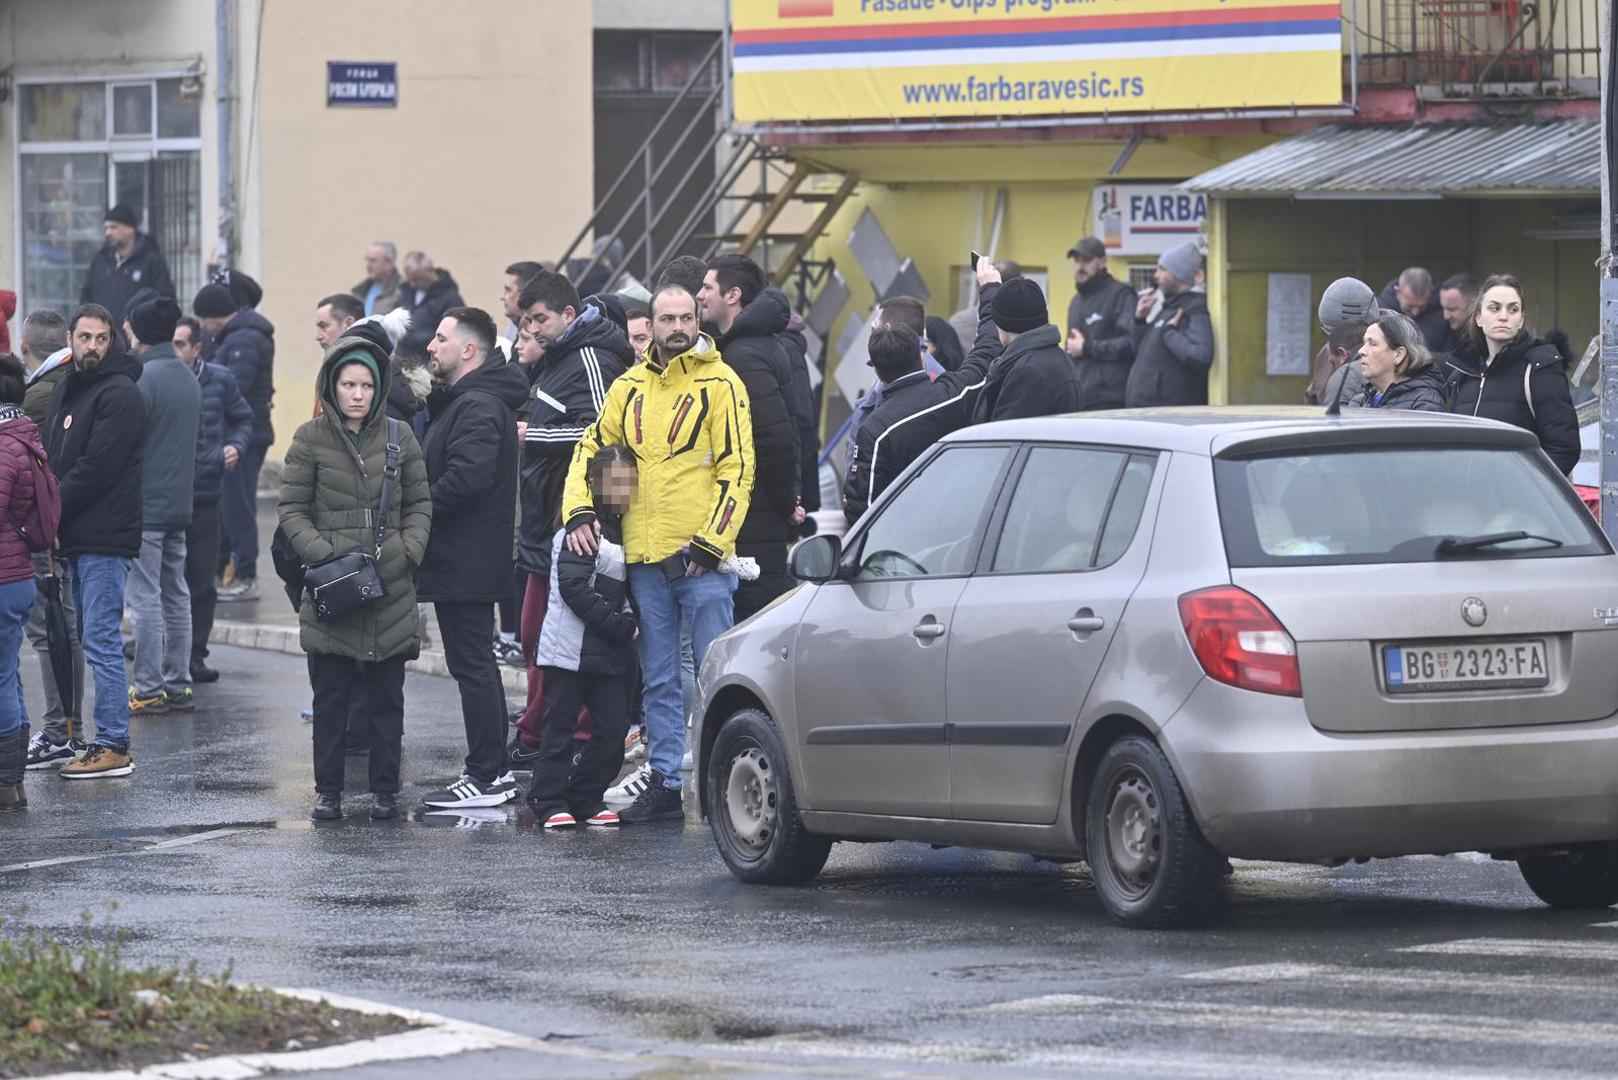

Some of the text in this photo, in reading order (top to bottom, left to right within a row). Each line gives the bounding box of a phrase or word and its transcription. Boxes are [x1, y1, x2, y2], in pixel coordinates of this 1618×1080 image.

[903, 72, 1144, 103] www.farbaravesic.rs
[1130, 195, 1206, 221] FARBA
[1406, 651, 1434, 679] BG
